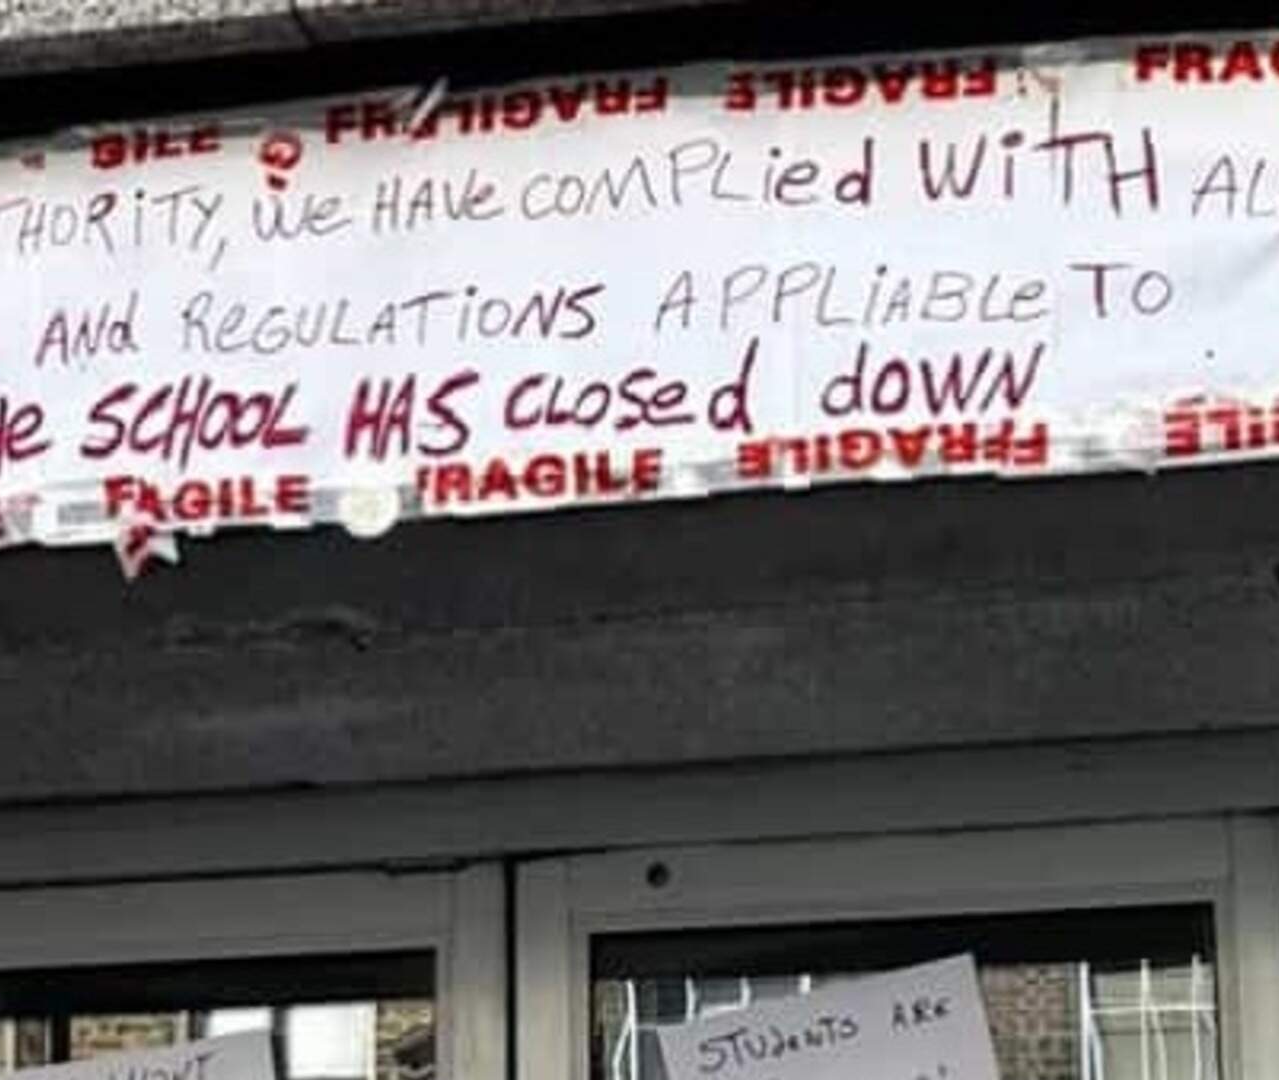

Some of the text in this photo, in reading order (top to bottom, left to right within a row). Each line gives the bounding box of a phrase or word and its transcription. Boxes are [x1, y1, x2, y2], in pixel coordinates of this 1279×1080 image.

[1070, 262, 1174, 320] TO
[80, 376, 310, 470] SCHOOL
[342, 370, 482, 462] HAS
